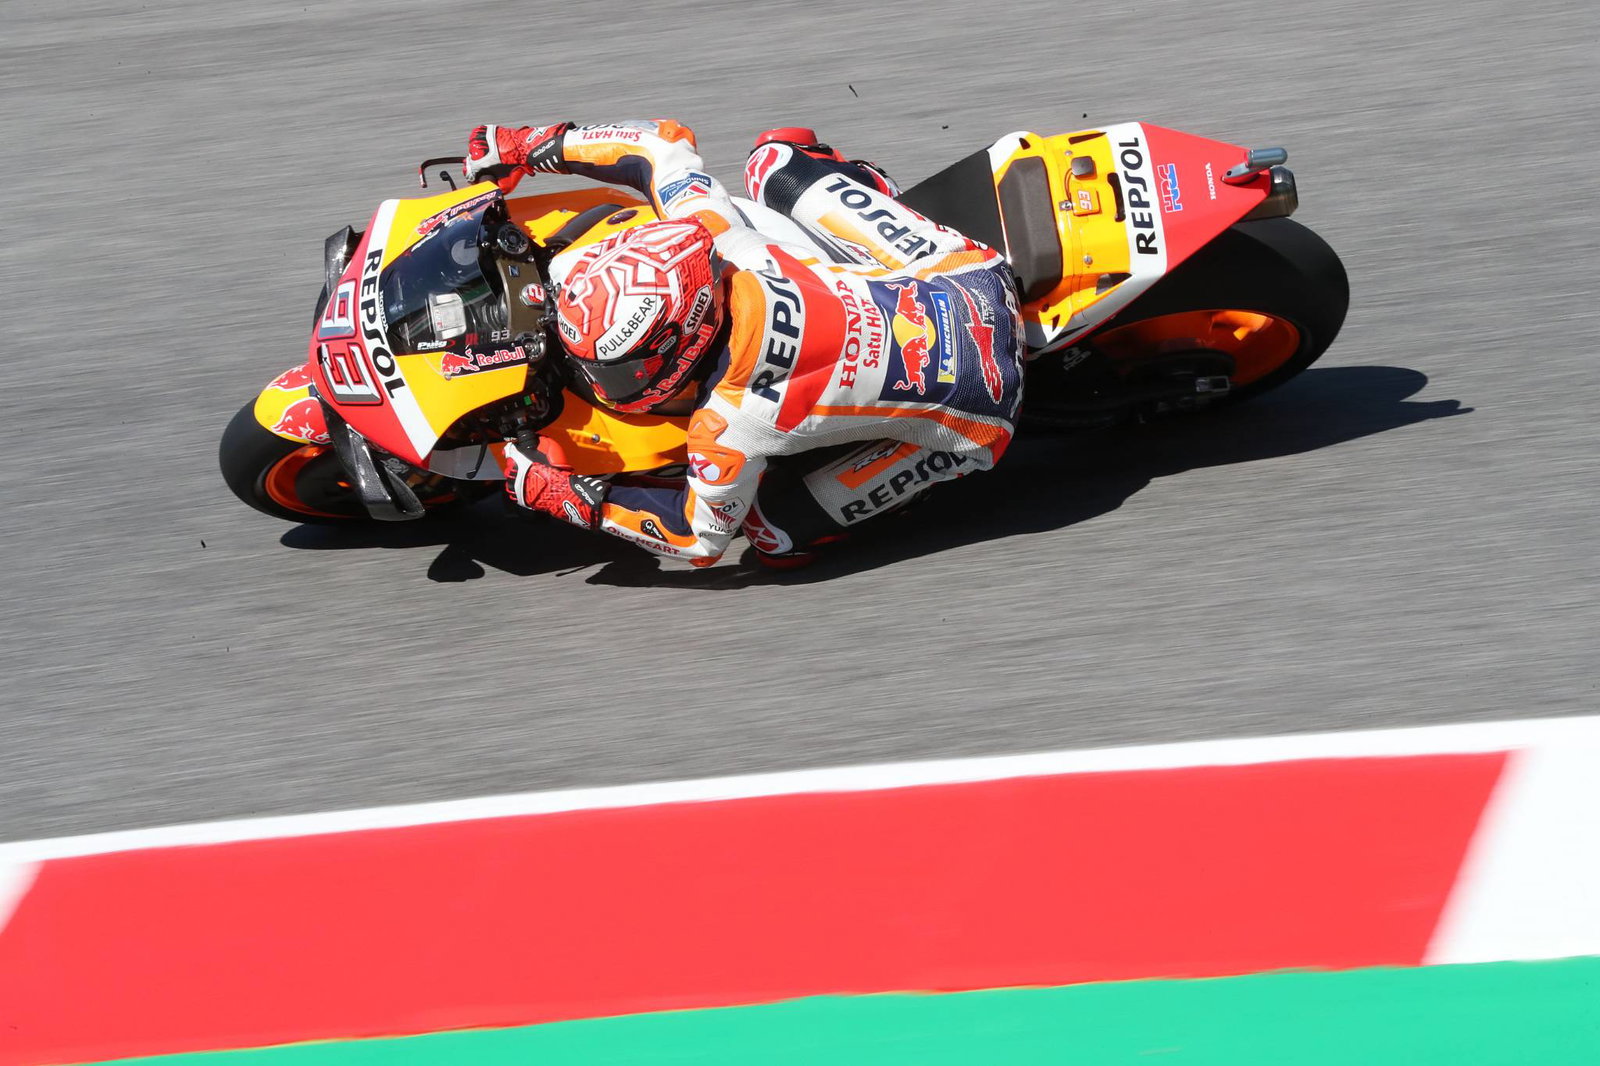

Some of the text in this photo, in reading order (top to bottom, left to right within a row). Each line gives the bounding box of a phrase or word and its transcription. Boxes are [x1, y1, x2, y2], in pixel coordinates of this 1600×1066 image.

[1078, 190, 1093, 210] 93
[1119, 137, 1158, 254] REPSOL
[1157, 163, 1183, 214] HRC
[1204, 162, 1216, 200] HONDA
[825, 177, 938, 260] REPSOL
[360, 248, 406, 399] REPSOL
[491, 329, 511, 342] 93
[558, 315, 577, 341] HOEI
[598, 296, 656, 356] PULL&BEAR
[687, 291, 710, 330] SHOEI
[861, 298, 883, 369] Satu HAT
[937, 299, 952, 356] MICHELIN
[476, 345, 527, 367] Red Bull
[656, 323, 714, 392] Red Bull
[840, 451, 968, 523] REPSOL
[606, 526, 634, 540] One
[635, 536, 681, 555] HEART
